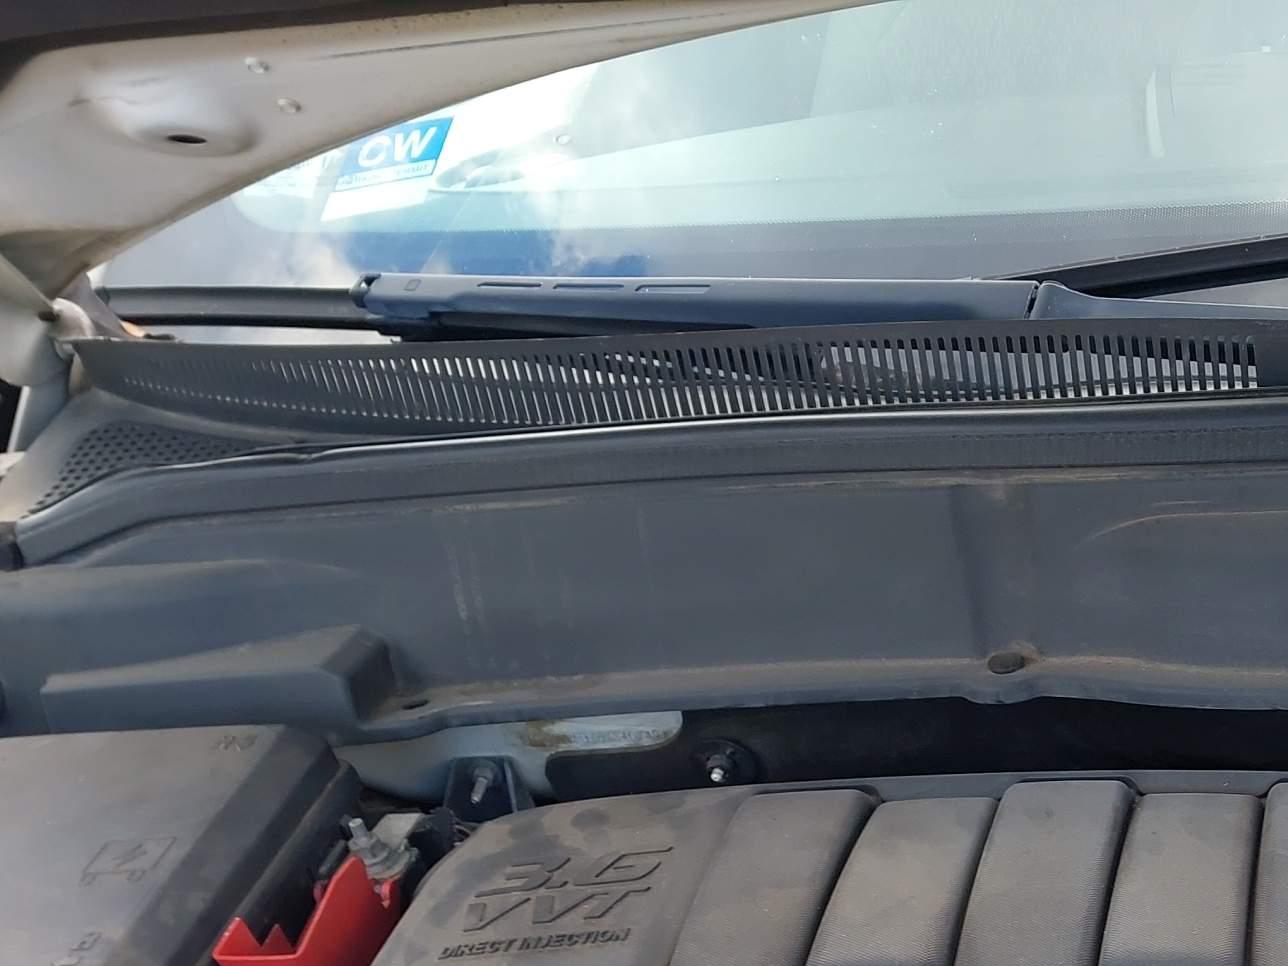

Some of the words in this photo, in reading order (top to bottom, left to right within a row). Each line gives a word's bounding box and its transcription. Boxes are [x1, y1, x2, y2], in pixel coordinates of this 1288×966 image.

[474, 845, 674, 898] 3.6
[437, 937, 518, 960] DIRECT
[518, 927, 632, 952] INJECTION
